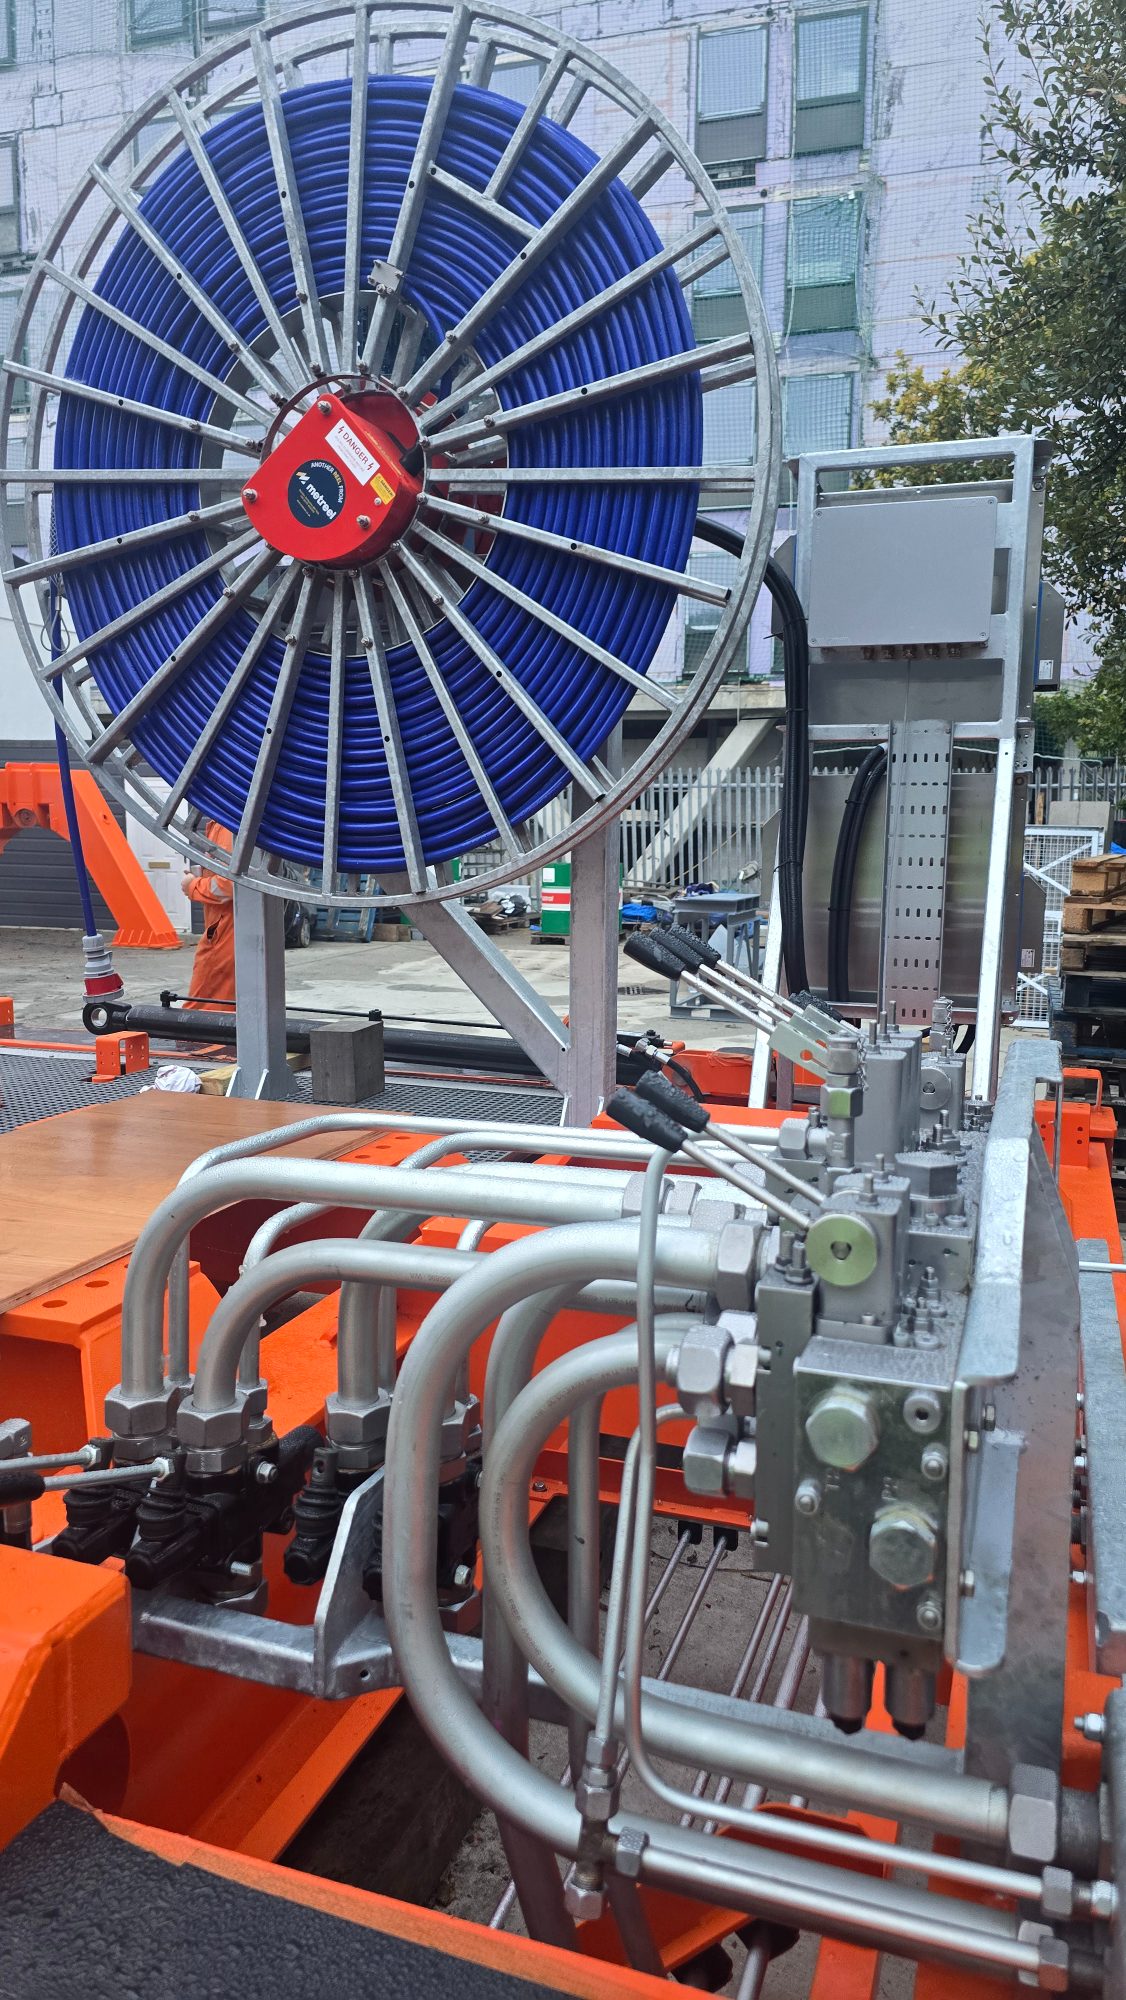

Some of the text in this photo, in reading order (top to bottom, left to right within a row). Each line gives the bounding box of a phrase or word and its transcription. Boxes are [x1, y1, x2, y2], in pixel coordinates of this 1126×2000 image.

[342, 432, 369, 464] DANGER
[311, 462, 334, 473] ANOTHER
[333, 471, 342, 485] REEL
[305, 483, 337, 520] metreel
